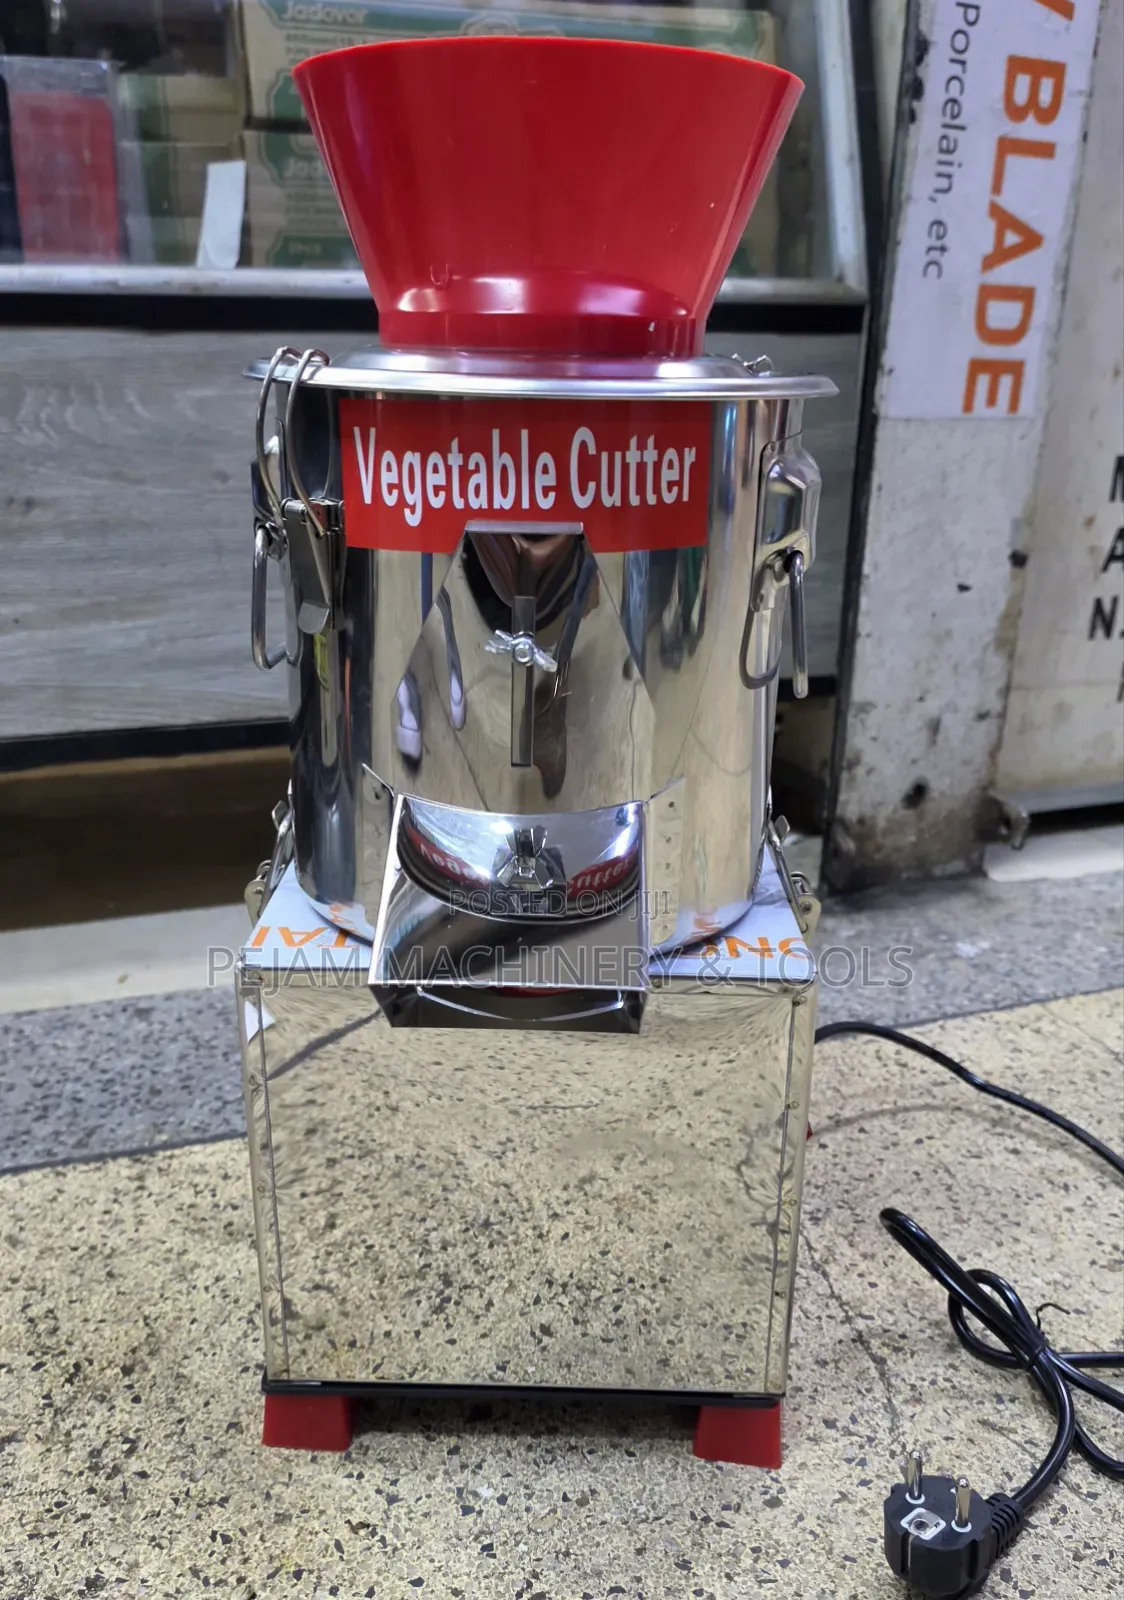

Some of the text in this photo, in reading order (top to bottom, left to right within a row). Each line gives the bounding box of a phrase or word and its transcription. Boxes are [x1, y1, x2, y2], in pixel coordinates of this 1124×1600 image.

[922, 1, 981, 280] Porcelain, etc
[962, 54, 1067, 414] BLADE
[353, 426, 697, 527] Vegetable Cutter
